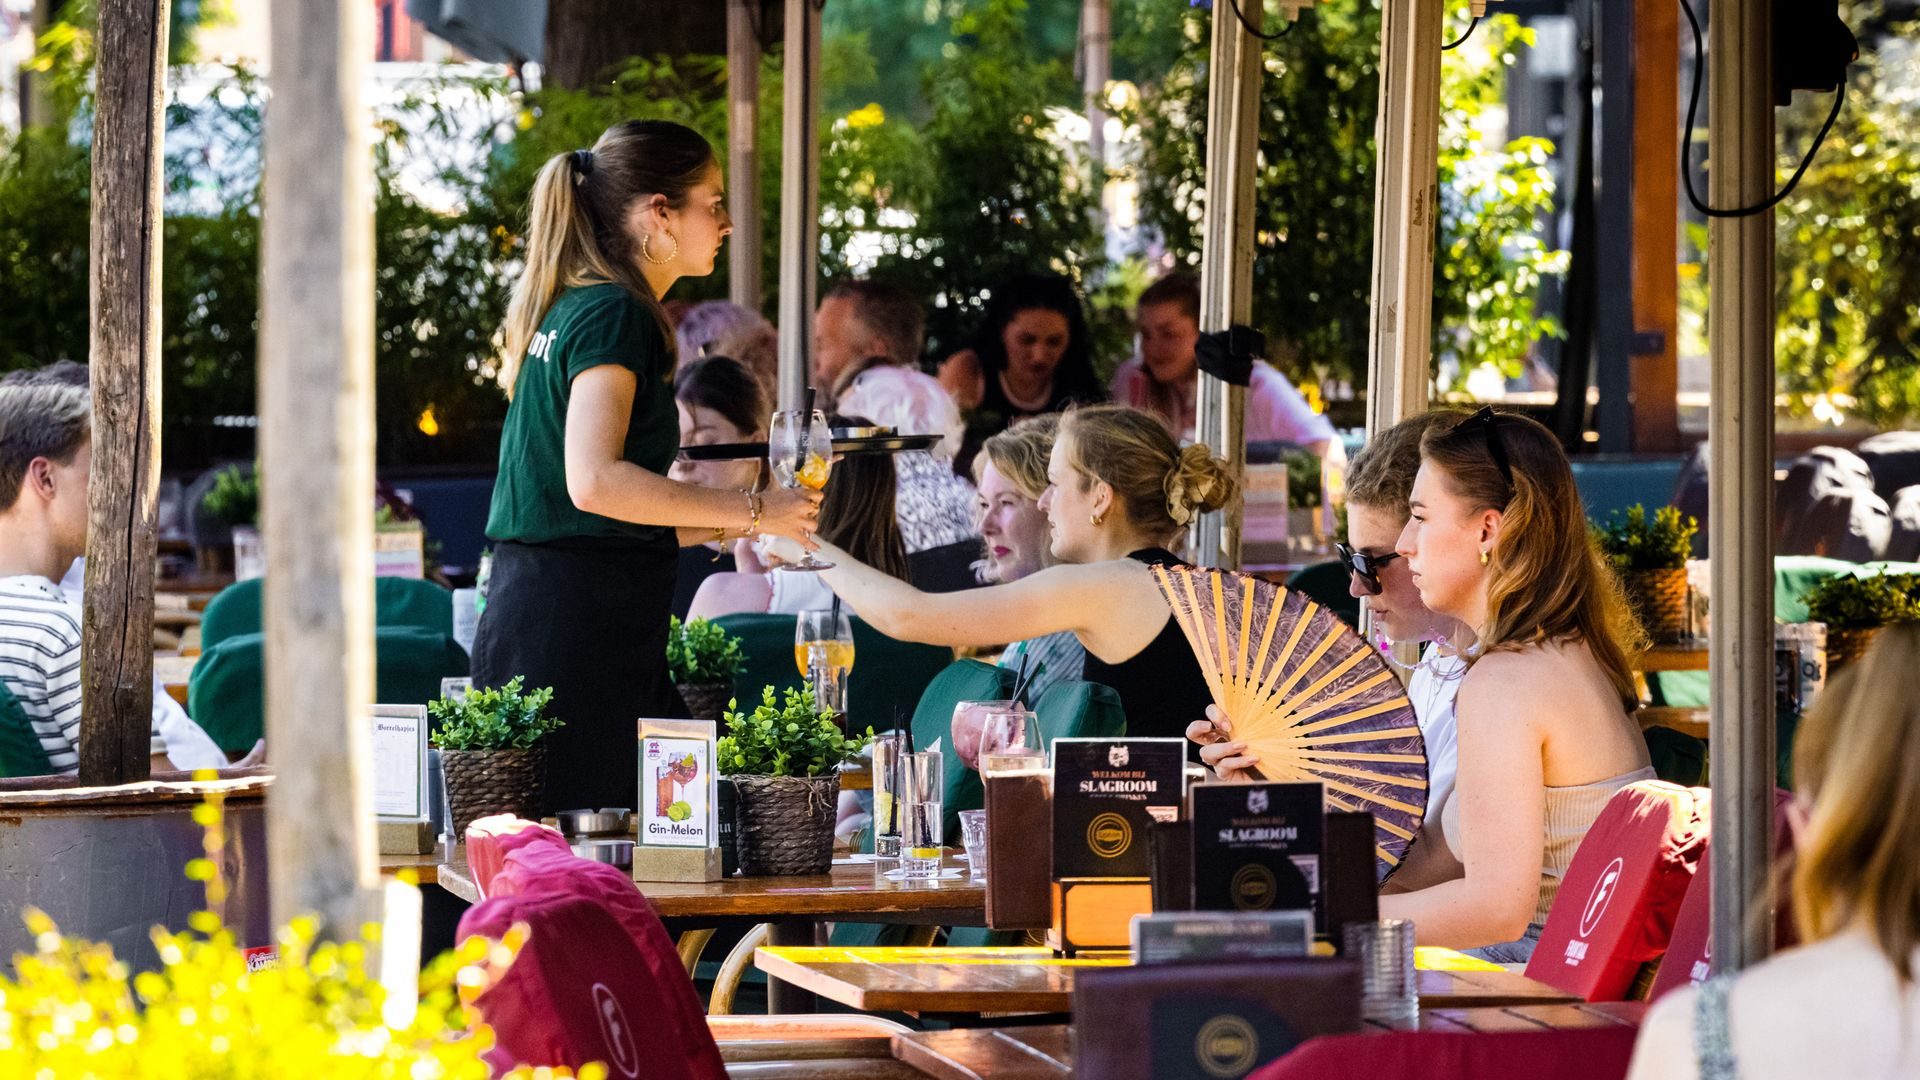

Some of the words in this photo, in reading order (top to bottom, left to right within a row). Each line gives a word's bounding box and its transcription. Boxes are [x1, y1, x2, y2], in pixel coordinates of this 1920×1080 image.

[1079, 780, 1158, 792] SLAGROOM
[648, 823, 703, 836] Gin-Melon
[1219, 827, 1298, 842] SLAGROOM
